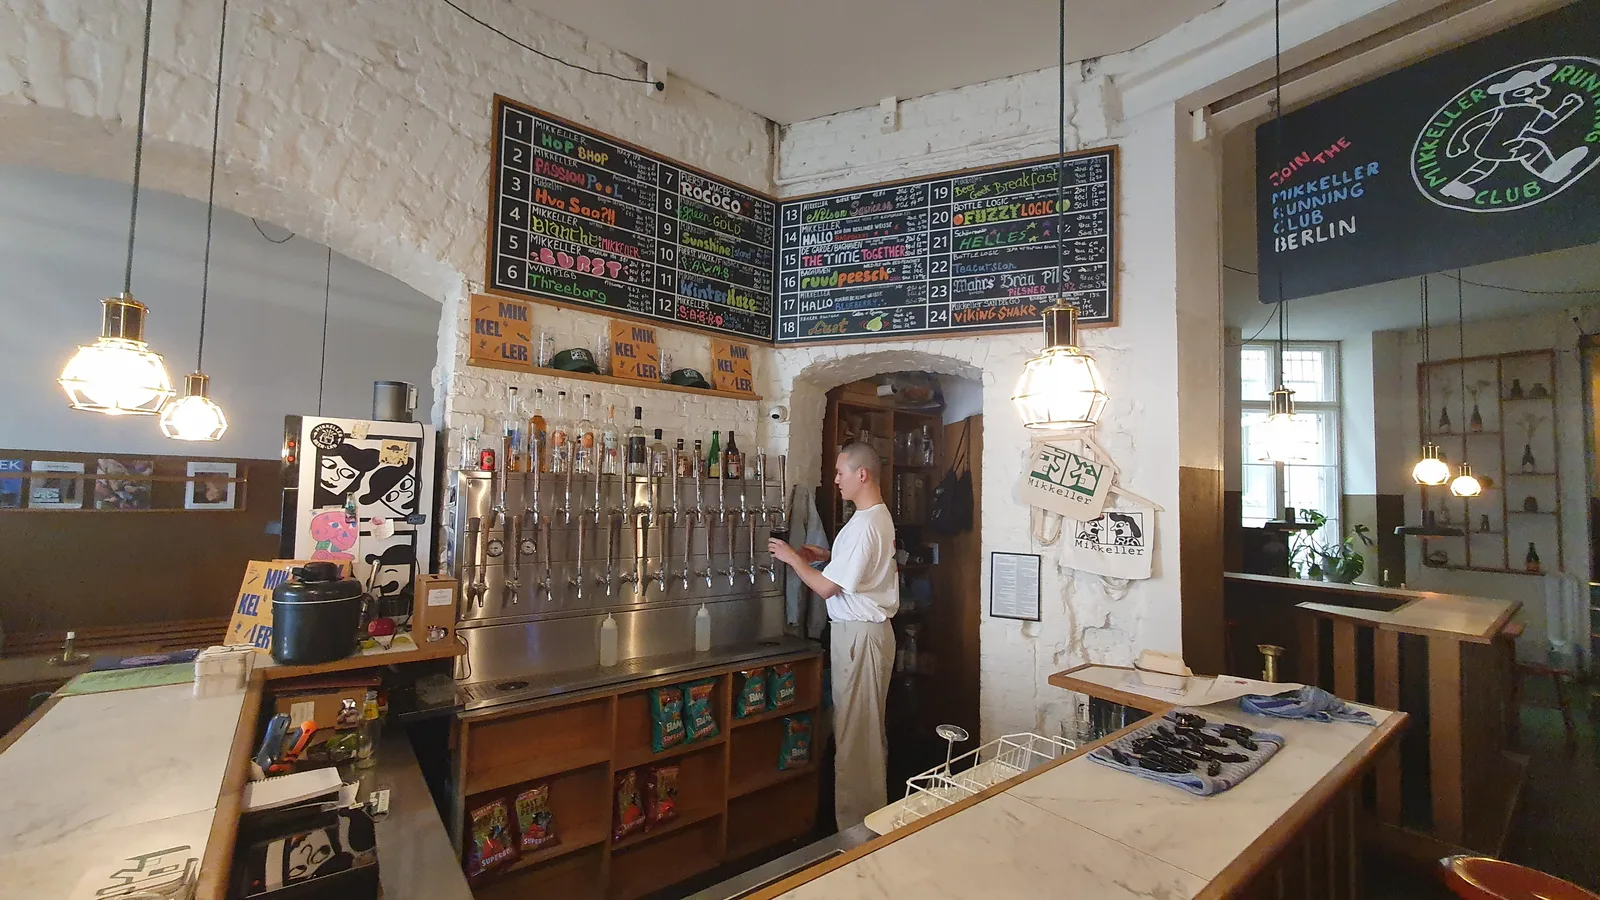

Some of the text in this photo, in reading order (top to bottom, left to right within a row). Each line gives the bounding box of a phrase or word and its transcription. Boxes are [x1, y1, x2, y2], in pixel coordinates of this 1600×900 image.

[516, 120, 523, 135] 1
[535, 120, 588, 146] MIKKELLER
[1418, 87, 1488, 189] MIKKELLER
[512, 148, 523, 164] 2
[541, 131, 609, 166] HOP SHOP
[534, 146, 579, 169] MIKKELLER
[1269, 136, 1352, 187] JOIN THE
[535, 157, 586, 186] PASSION
[665, 172, 674, 185] 7
[511, 177, 521, 192] 3
[681, 172, 704, 187] FUERST
[954, 184, 976, 197] Beer
[969, 184, 991, 199] Geek
[993, 170, 1059, 195] Breakfast
[1272, 160, 1380, 205] MIKKELLER
[680, 182, 741, 214] ROCOCO
[933, 187, 949, 199] 19
[1273, 182, 1364, 219] RUNNING
[1474, 180, 1542, 206] CLUB
[664, 198, 672, 210] 8
[803, 200, 829, 212] MIKKELLER
[953, 197, 1009, 212] BOTTLE LOGIC
[509, 207, 521, 221] 4
[532, 206, 578, 227] MIKKELLER
[785, 209, 798, 221] 13
[806, 207, 848, 223] Nelson
[931, 211, 949, 224] 20
[964, 199, 1054, 225] FUZZY LOGIC
[663, 223, 672, 235] 9
[713, 215, 742, 235] GOLD
[802, 221, 841, 233] MIKKELLER
[1273, 208, 1324, 235] CLUB
[784, 232, 798, 243] 14
[802, 231, 833, 246] HALLO
[933, 235, 948, 248] 21
[958, 230, 1027, 250] HELLES
[1274, 215, 1357, 253] BERLIN
[509, 236, 518, 249] 5
[530, 234, 582, 256] MIKKELLER
[682, 231, 731, 257] Sunshine
[660, 247, 674, 261] 10
[678, 246, 697, 259] FUERST
[801, 244, 906, 268] THE TIME TOGETHER
[802, 246, 809, 255] DE
[953, 249, 1000, 261] BOTTLE LOGIC
[784, 254, 796, 266] 15
[931, 260, 948, 273] 22
[507, 265, 518, 279] 6
[952, 262, 1018, 274] Teacursion
[660, 273, 672, 286] 11
[783, 276, 796, 288] 16
[953, 267, 1072, 294] Mahrs Bräu Pils
[680, 279, 728, 304] Winter
[800, 290, 831, 299] MIKKELLER
[930, 285, 948, 298] 23
[658, 298, 672, 313] 12
[677, 296, 710, 310] MIKKELLER
[783, 299, 796, 311] 17
[801, 298, 833, 312] HALLO
[835, 299, 878, 311] BLUEBERRY
[983, 299, 997, 308] SAN
[997, 297, 1020, 307] DIEGO
[499, 302, 527, 321] MIK
[679, 304, 724, 326] SABRO
[930, 310, 948, 323] 24
[475, 318, 502, 338] KEL
[782, 321, 795, 333] 18
[632, 327, 655, 344] MIK
[501, 343, 528, 362] LER
[615, 341, 636, 359] KEL
[730, 344, 749, 360] MIK
[636, 362, 657, 379] LER
[717, 359, 734, 373] KEL
[736, 377, 752, 392] LER
[1027, 476, 1092, 506] Mikkeller
[1074, 539, 1145, 556] Mikkeller
[237, 593, 261, 617] KEL
[249, 624, 273, 650] LER
